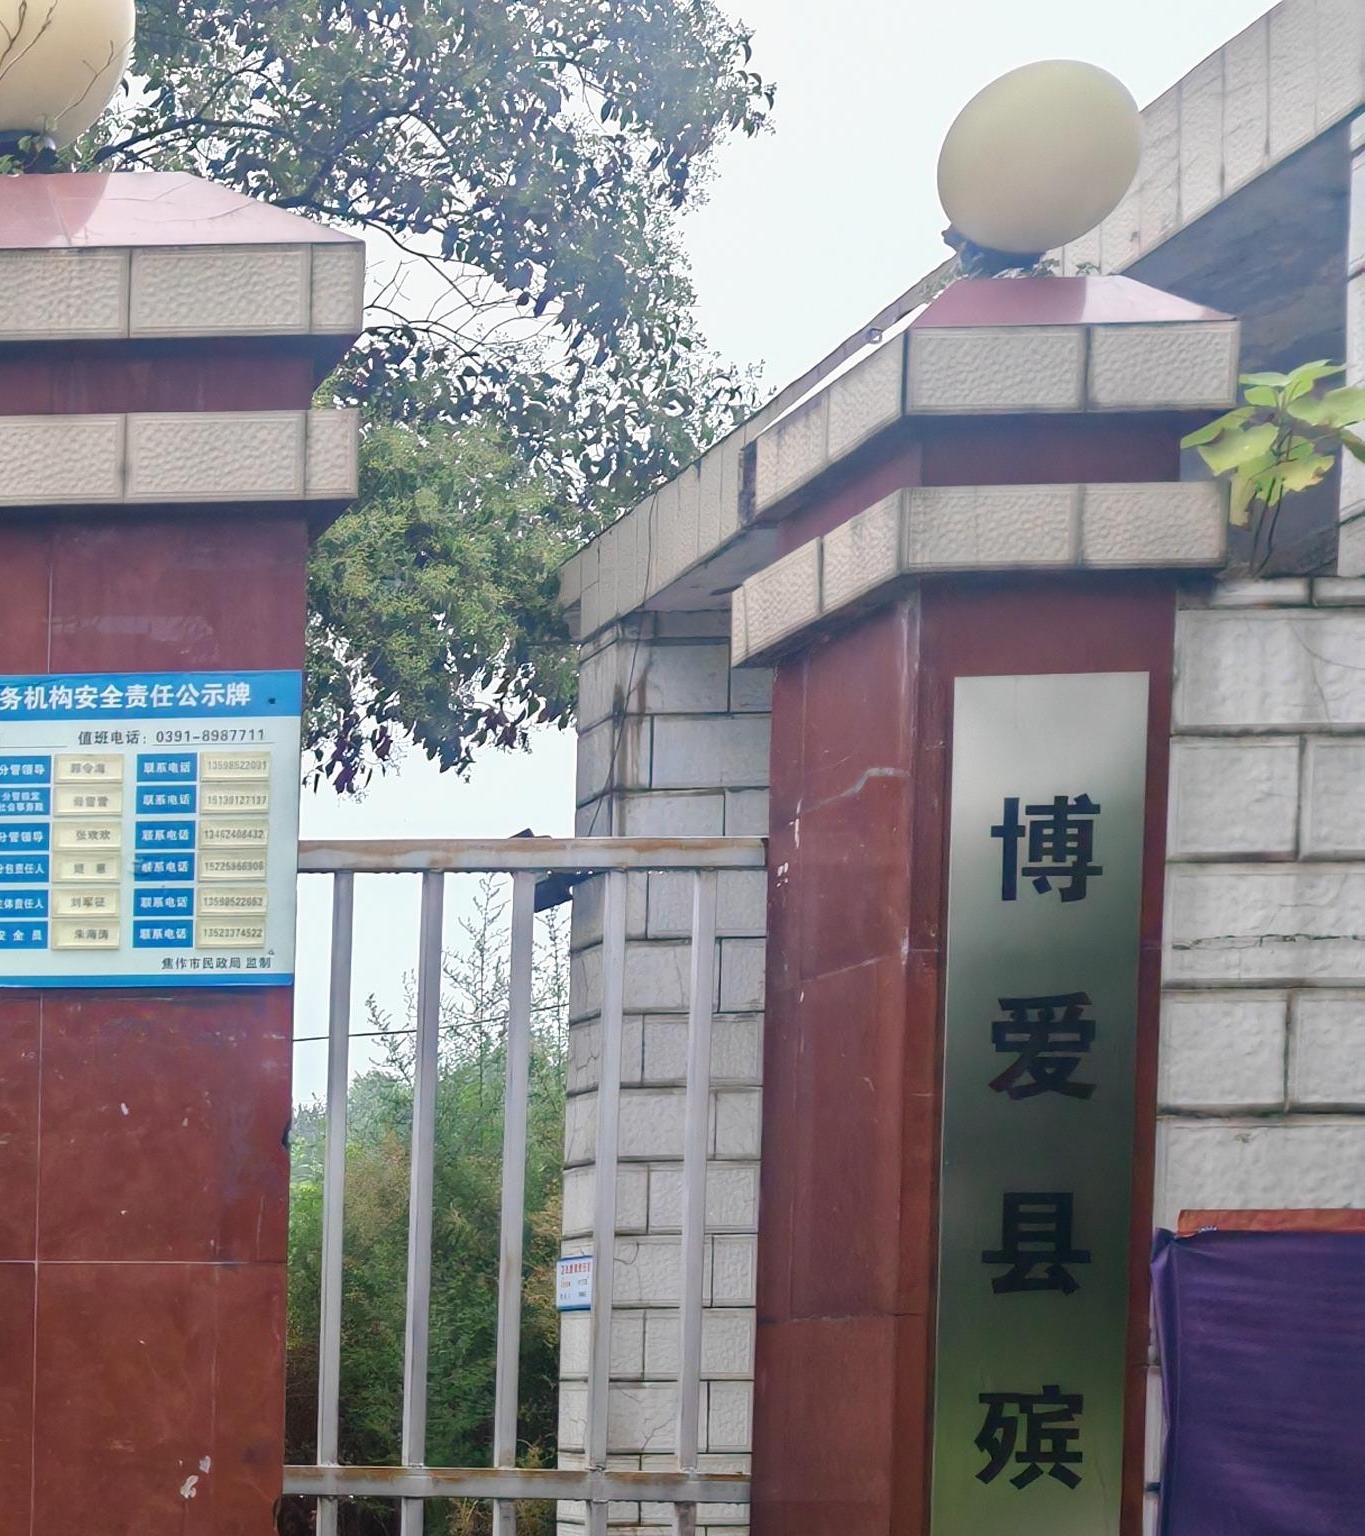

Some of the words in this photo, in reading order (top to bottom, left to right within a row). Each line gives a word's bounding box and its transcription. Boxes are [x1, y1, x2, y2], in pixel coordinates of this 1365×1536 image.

[156, 729, 265, 743] 0391-8987711
[144, 761, 190, 774] 联系电话
[143, 793, 190, 805] 联系电话
[142, 829, 189, 841] 联系电话
[141, 860, 189, 873] 联系电话
[140, 896, 188, 908] 联系电话
[140, 928, 187, 940] 联系电话
[161, 957, 241, 970] 焦作市民政局
[245, 956, 271, 969] 监制
